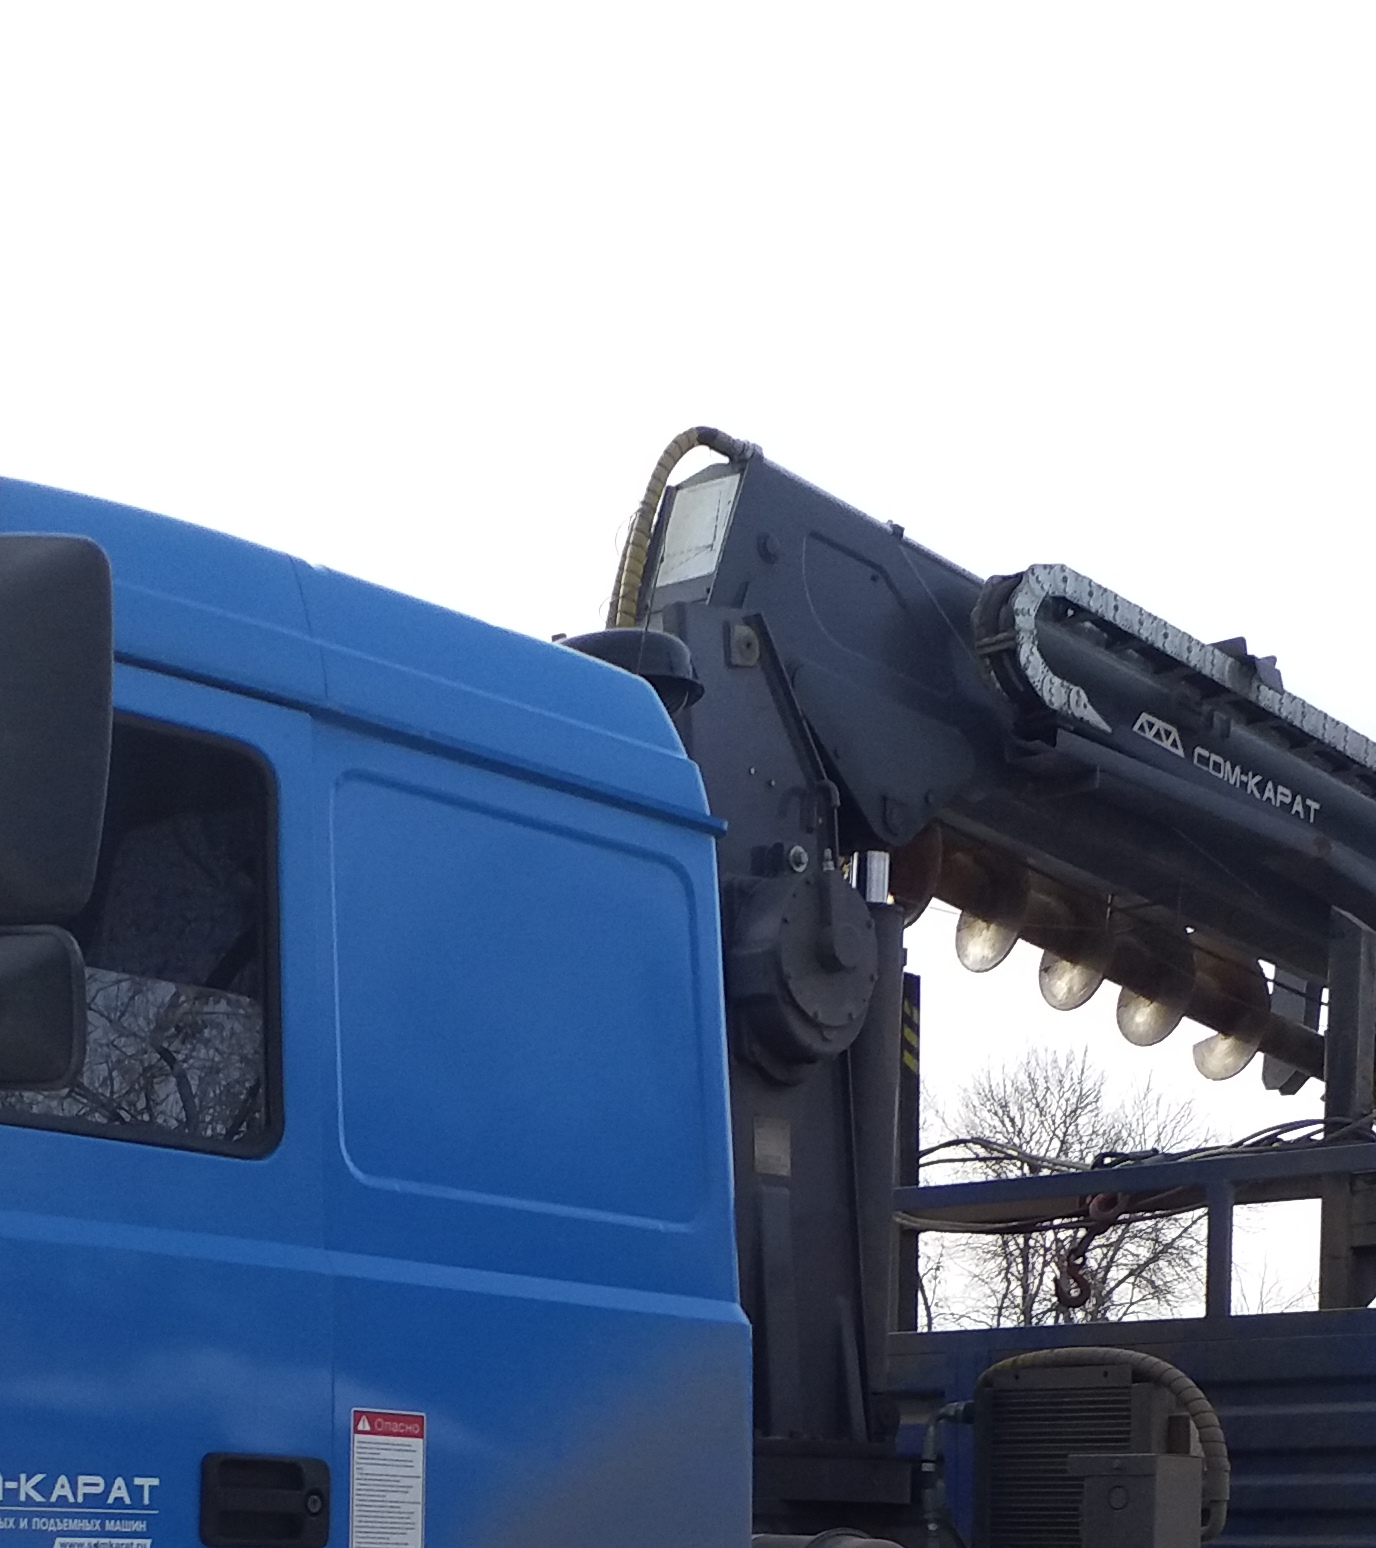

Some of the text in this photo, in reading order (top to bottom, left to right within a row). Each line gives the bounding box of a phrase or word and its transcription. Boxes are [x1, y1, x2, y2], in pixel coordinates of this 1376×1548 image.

[374, 1417, 420, 1435] Опасно
[18, 1517, 29, 1530] И
[31, 1517, 102, 1532] ПОДЪЕМНЫХ
[104, 1519, 147, 1532] МАШИН
